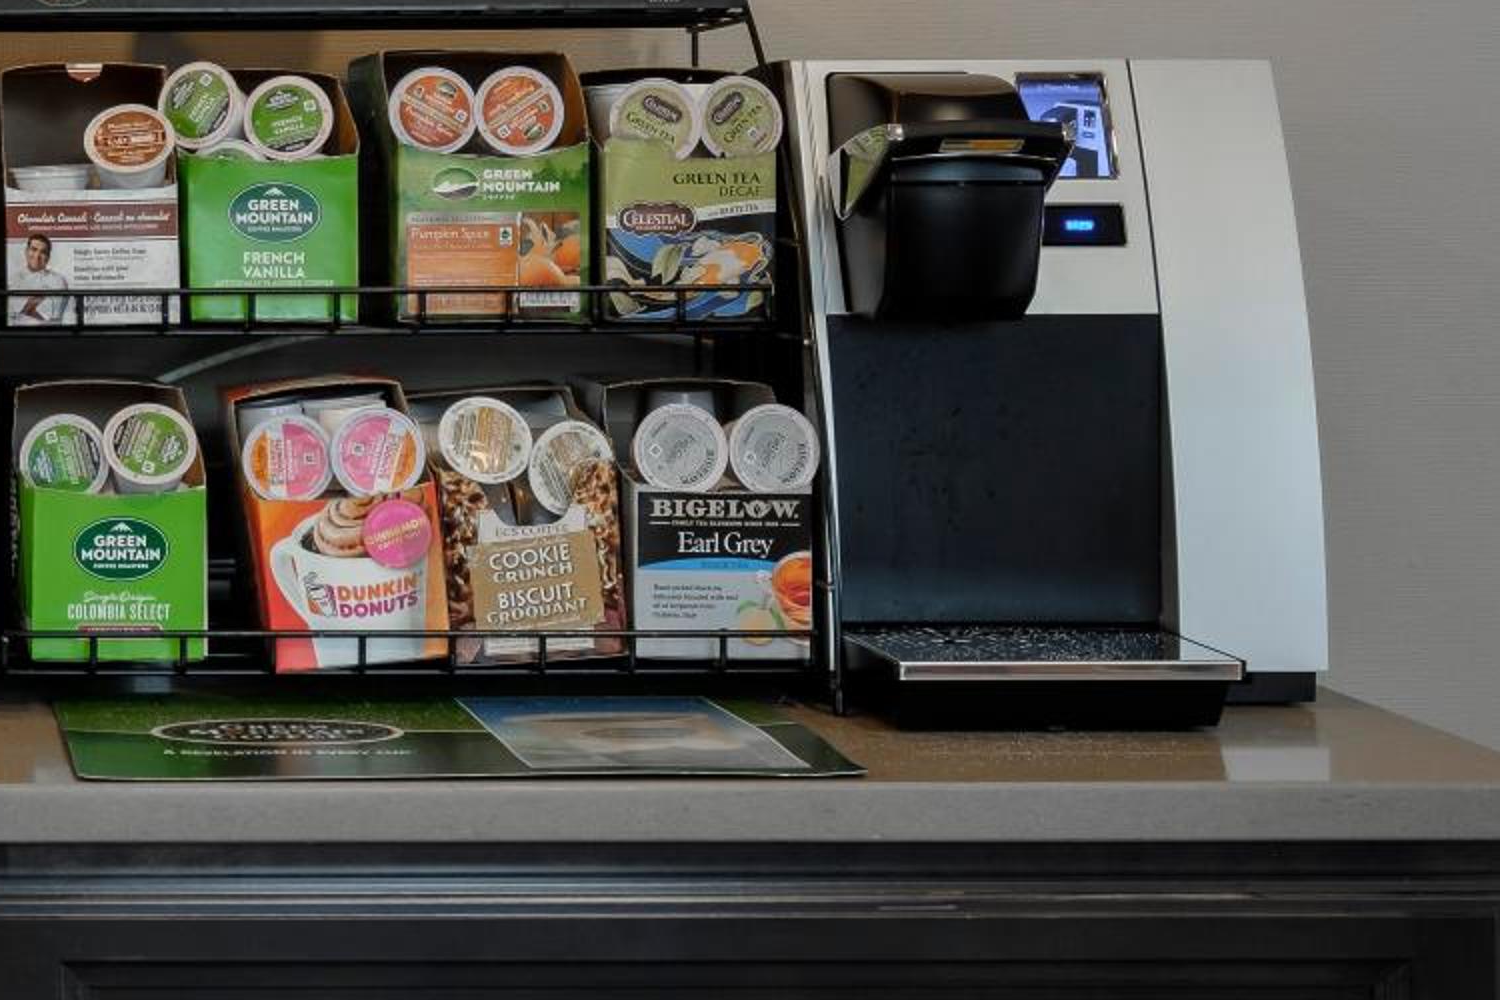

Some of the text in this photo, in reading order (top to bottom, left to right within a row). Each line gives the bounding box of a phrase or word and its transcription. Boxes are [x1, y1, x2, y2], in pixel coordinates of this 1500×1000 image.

[484, 169, 532, 180] GREEN
[673, 172, 761, 184] GREEN TEA
[483, 181, 560, 193] MOUNTAIN
[719, 186, 762, 197] DECAF
[248, 199, 299, 211] GREEN
[235, 212, 313, 225] MOUNTAIN
[622, 209, 690, 227] CELESTIAL
[243, 252, 305, 264] FRENCH
[243, 266, 306, 278] VANILLA
[94, 535, 147, 547] GREEN
[677, 532, 773, 559] Earl Grey
[81, 548, 161, 561] MOUNTAIN
[489, 543, 571, 570] COOKIE
[493, 562, 573, 584] CRUNCH
[498, 582, 573, 610] BISCUIT
[339, 591, 420, 618] DONUTS
[487, 597, 587, 625] CROQUANT
[67, 603, 171, 620] COLOMBIA SELECT
